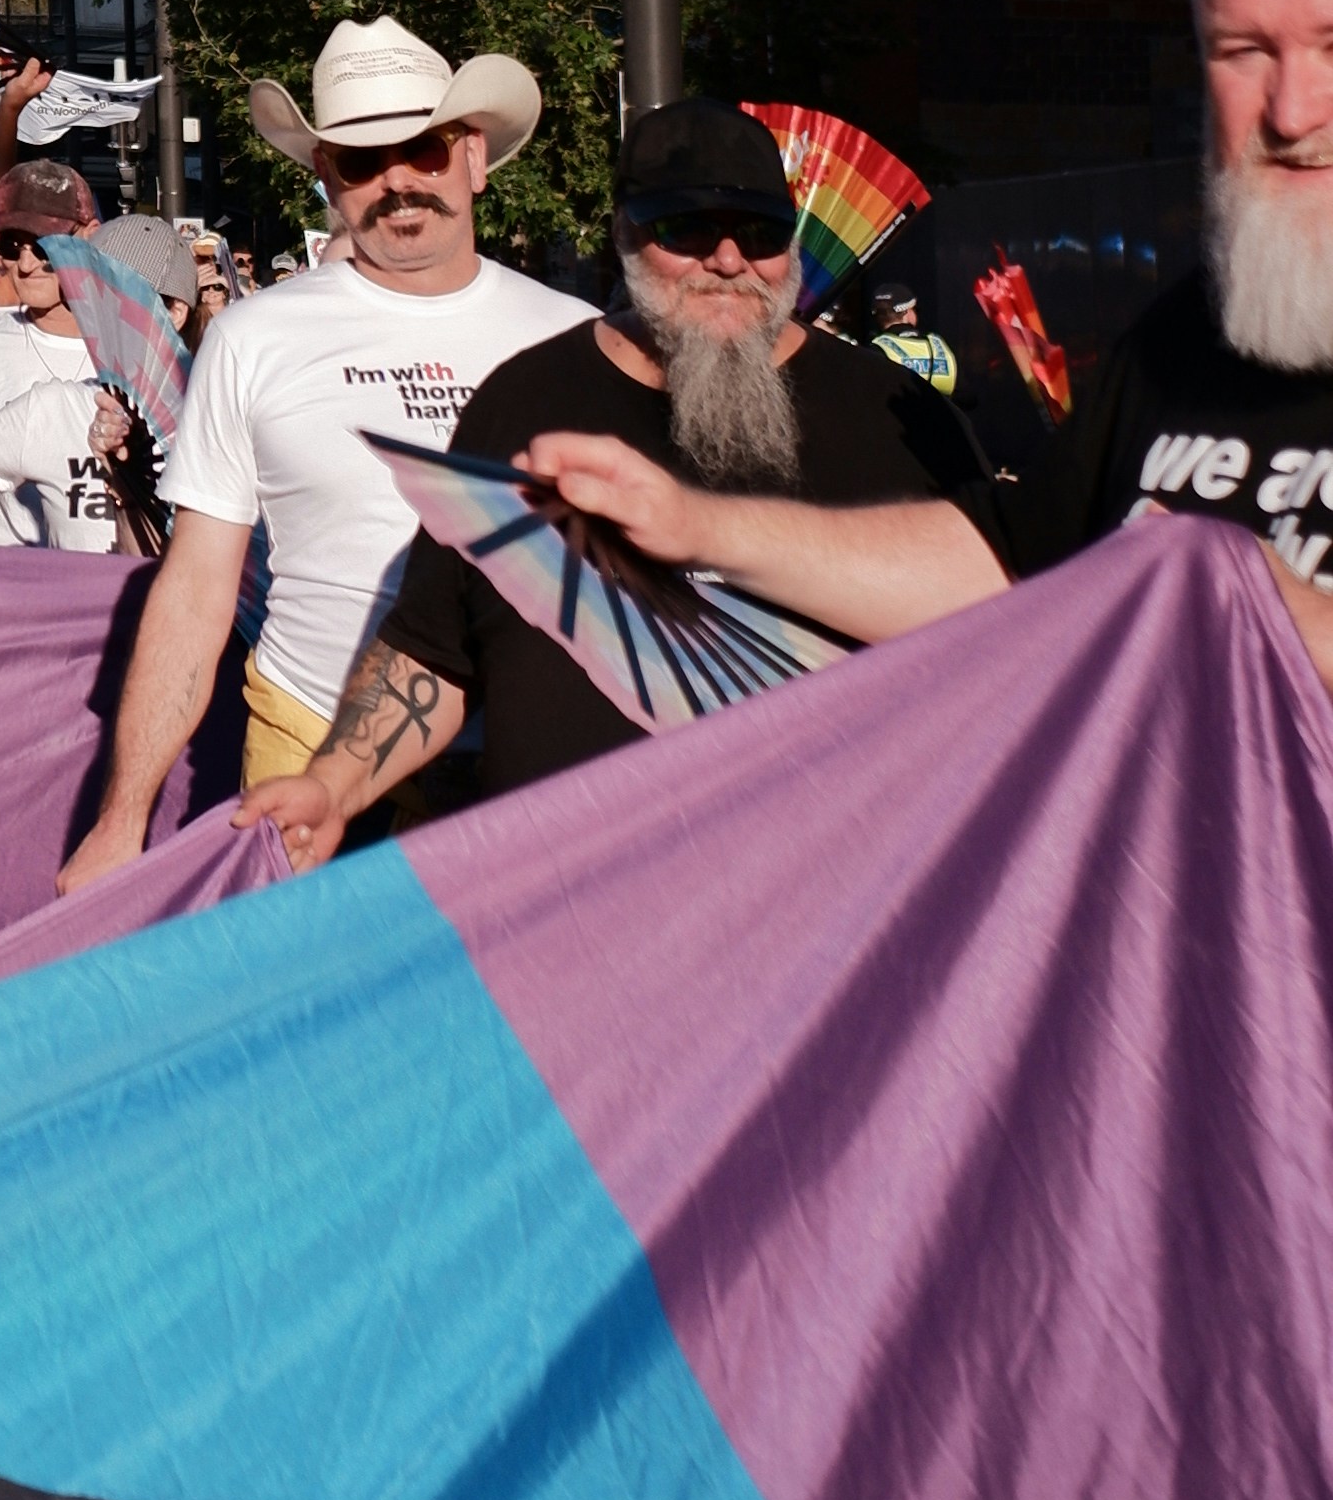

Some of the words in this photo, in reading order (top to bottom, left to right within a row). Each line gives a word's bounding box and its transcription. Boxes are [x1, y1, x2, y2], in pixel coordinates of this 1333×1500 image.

[342, 366, 386, 385] I'm
[388, 362, 455, 383] with
[397, 383, 476, 401] thorn
[1139, 433, 1251, 500] we
[1256, 448, 1333, 514] ar
